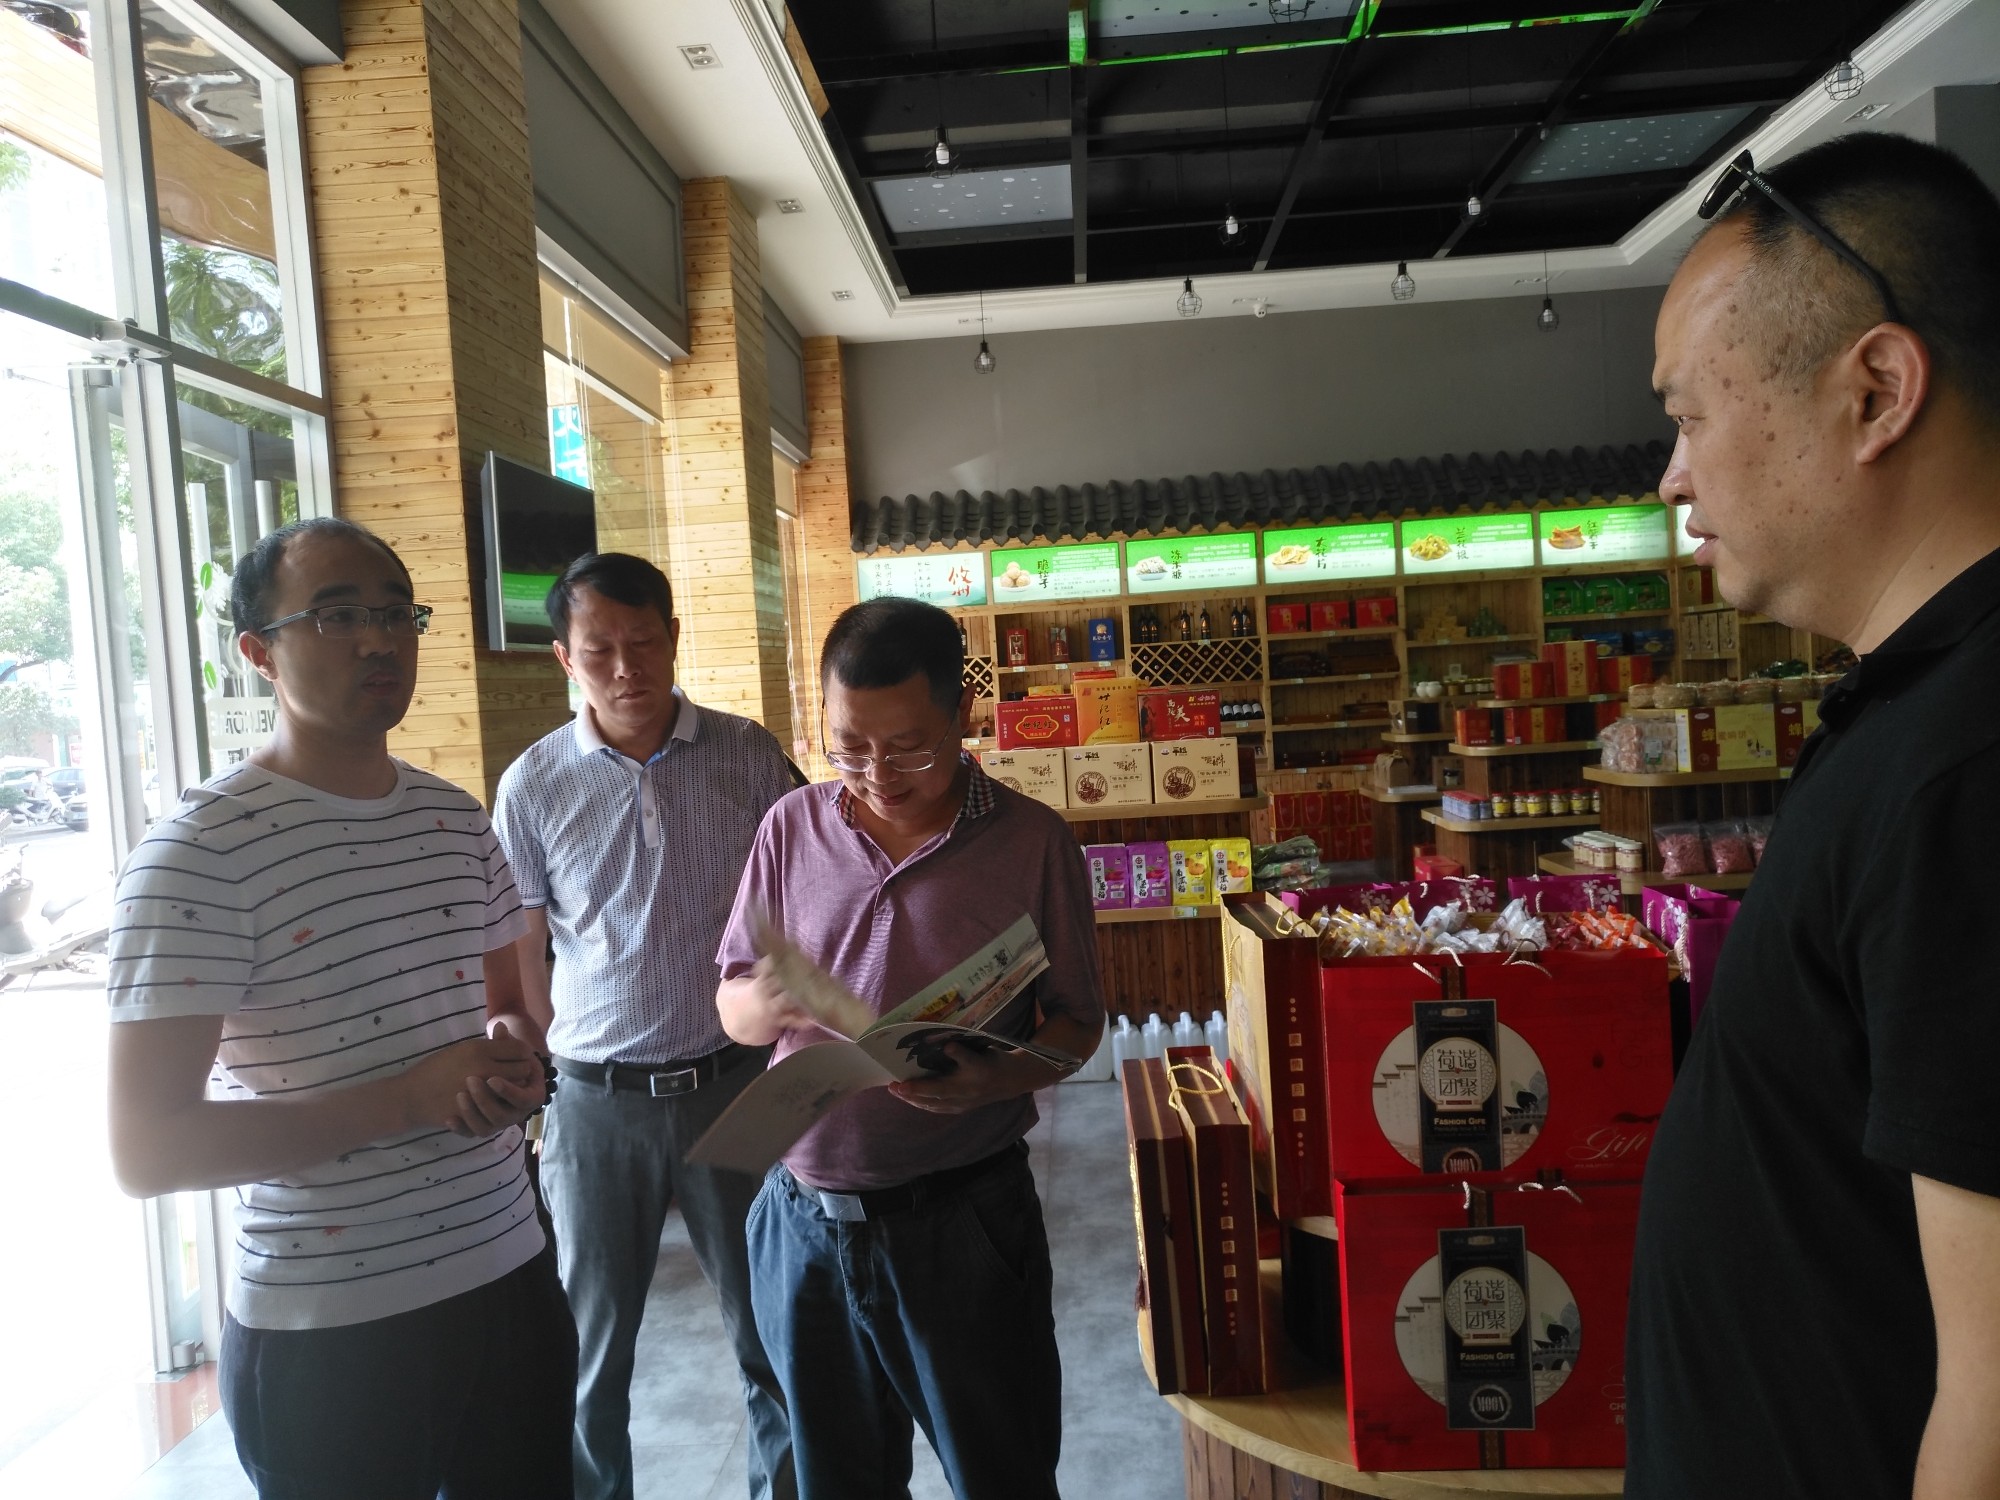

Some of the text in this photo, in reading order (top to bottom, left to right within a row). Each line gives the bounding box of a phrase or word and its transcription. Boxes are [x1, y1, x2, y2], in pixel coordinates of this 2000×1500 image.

[1753, 176, 1774, 194] BOLON
[1315, 536, 1328, 569] 大花片
[1170, 549, 1183, 580] 冻米糖
[1022, 720, 1053, 730] 世纪红
[1438, 1049, 1478, 1070] 荷谐
[1438, 1077, 1479, 1097] 团聚
[1433, 1117, 1467, 1126] FASHION
[1463, 1279, 1506, 1302] 荷谐
[1465, 1309, 1507, 1330] 团聚
[1460, 1351, 1495, 1361] FASHION
